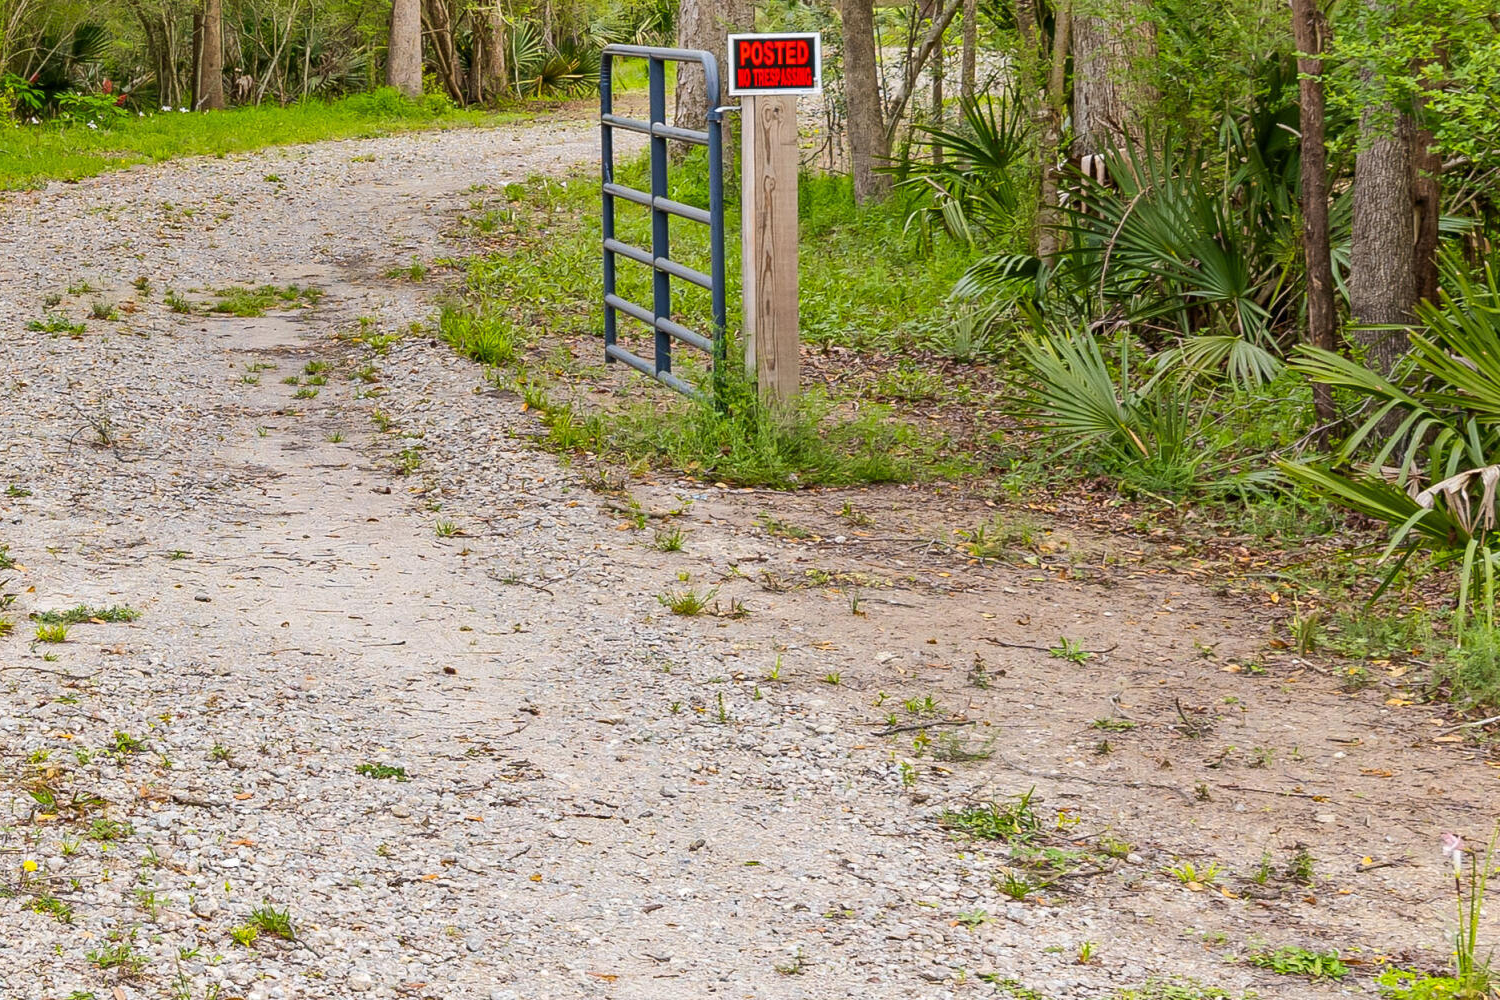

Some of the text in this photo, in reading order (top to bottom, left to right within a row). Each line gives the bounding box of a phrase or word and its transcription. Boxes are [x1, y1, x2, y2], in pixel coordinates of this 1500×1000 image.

[739, 40, 809, 66] POSTED
[737, 67, 811, 87] NO TRESPASSING
